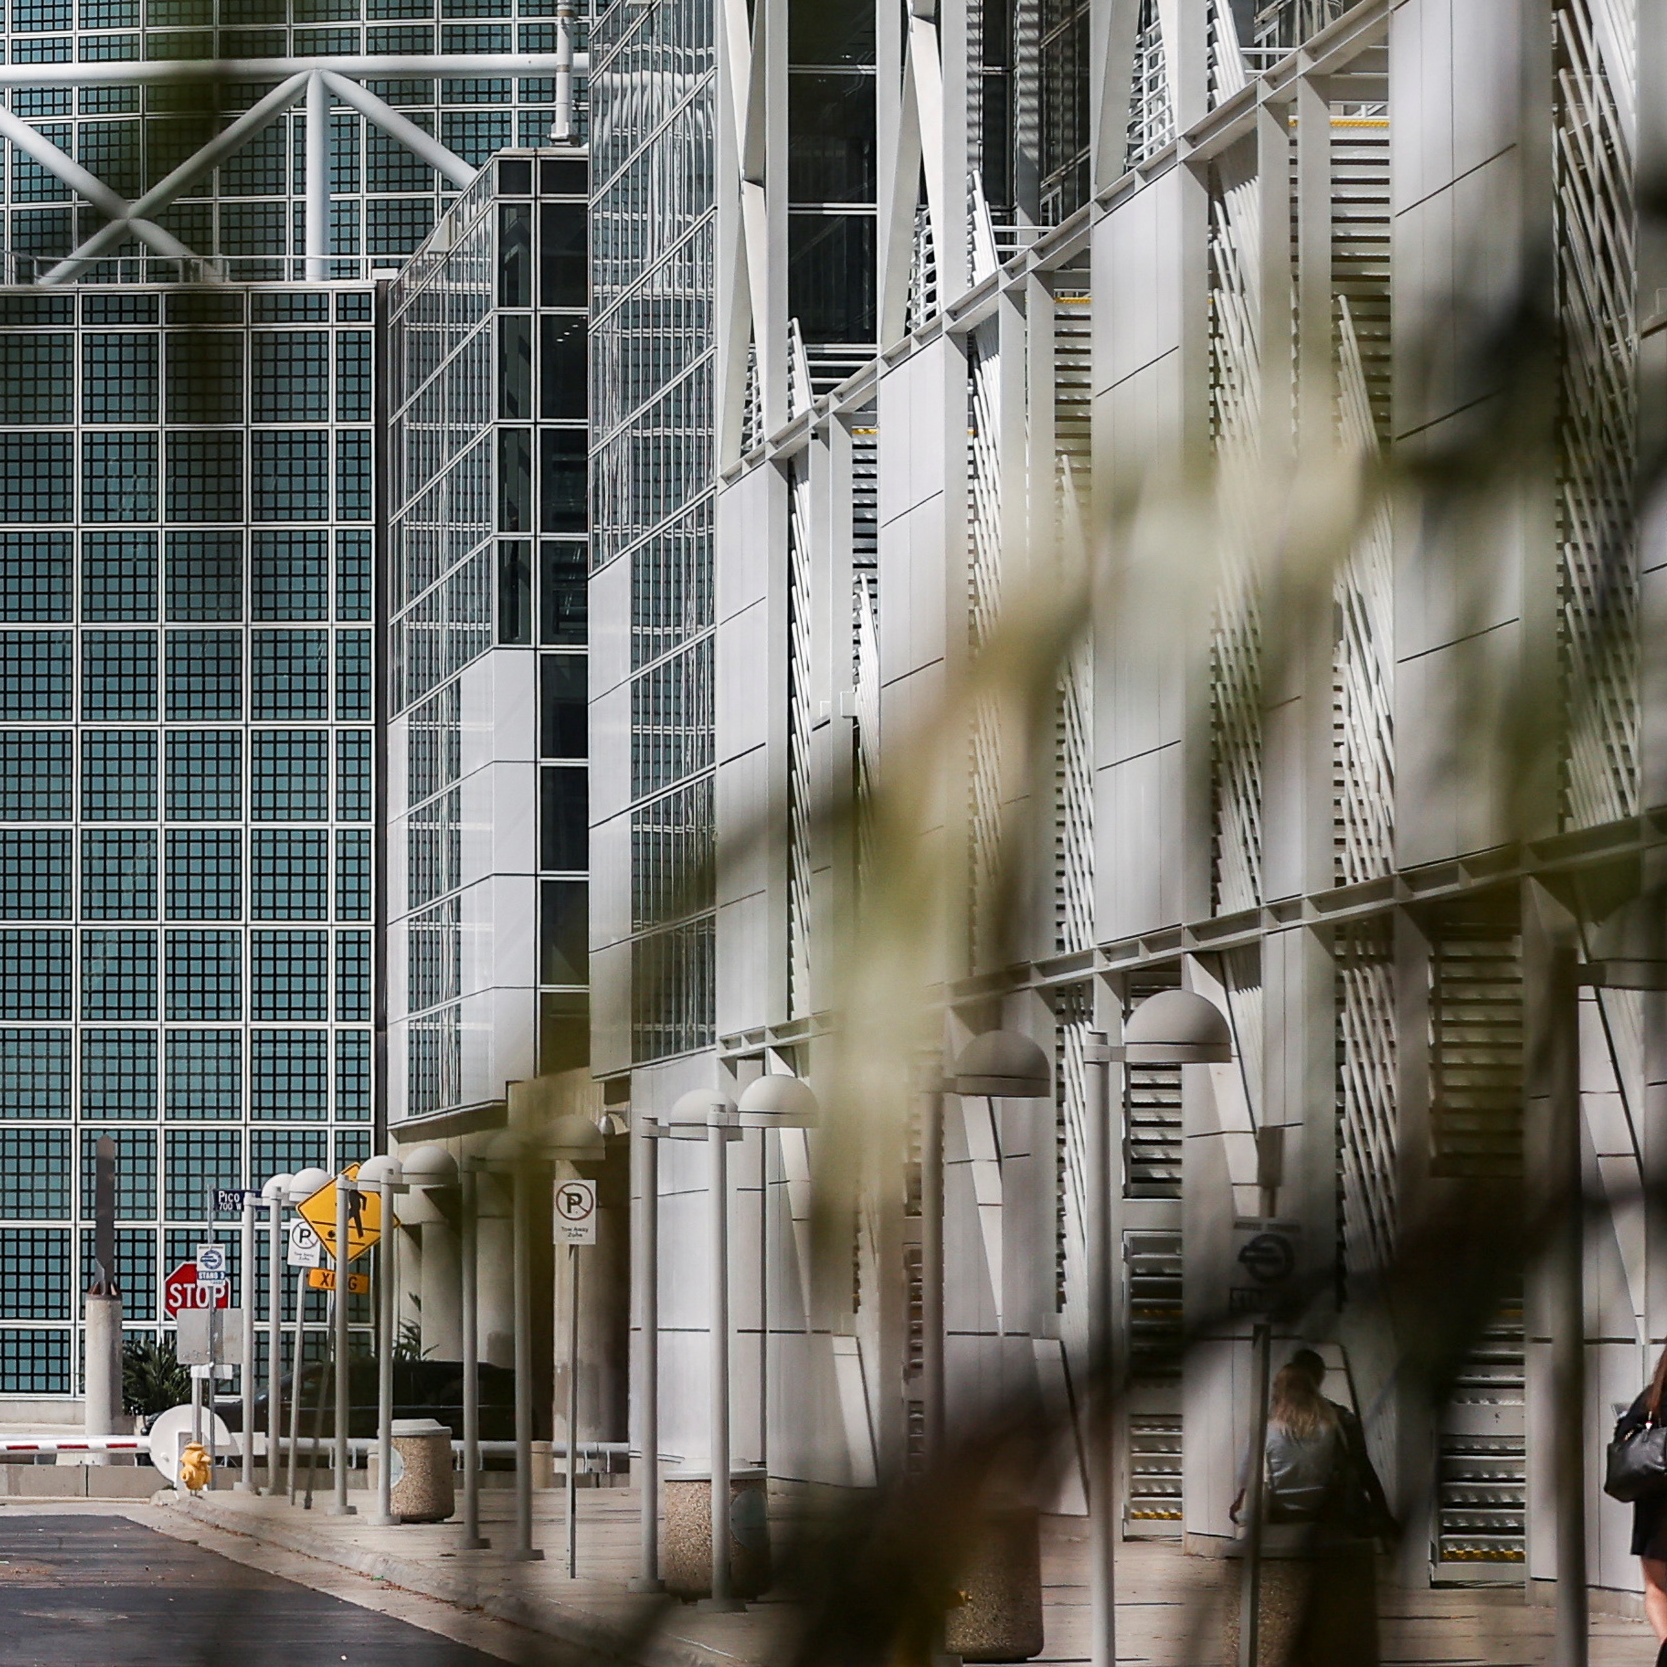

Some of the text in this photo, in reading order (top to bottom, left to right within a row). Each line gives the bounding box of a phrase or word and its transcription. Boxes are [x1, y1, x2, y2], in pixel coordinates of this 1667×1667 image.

[219, 1202, 233, 1210] 700
[320, 1272, 358, 1291] XIG
[168, 1282, 226, 1308] STOP
